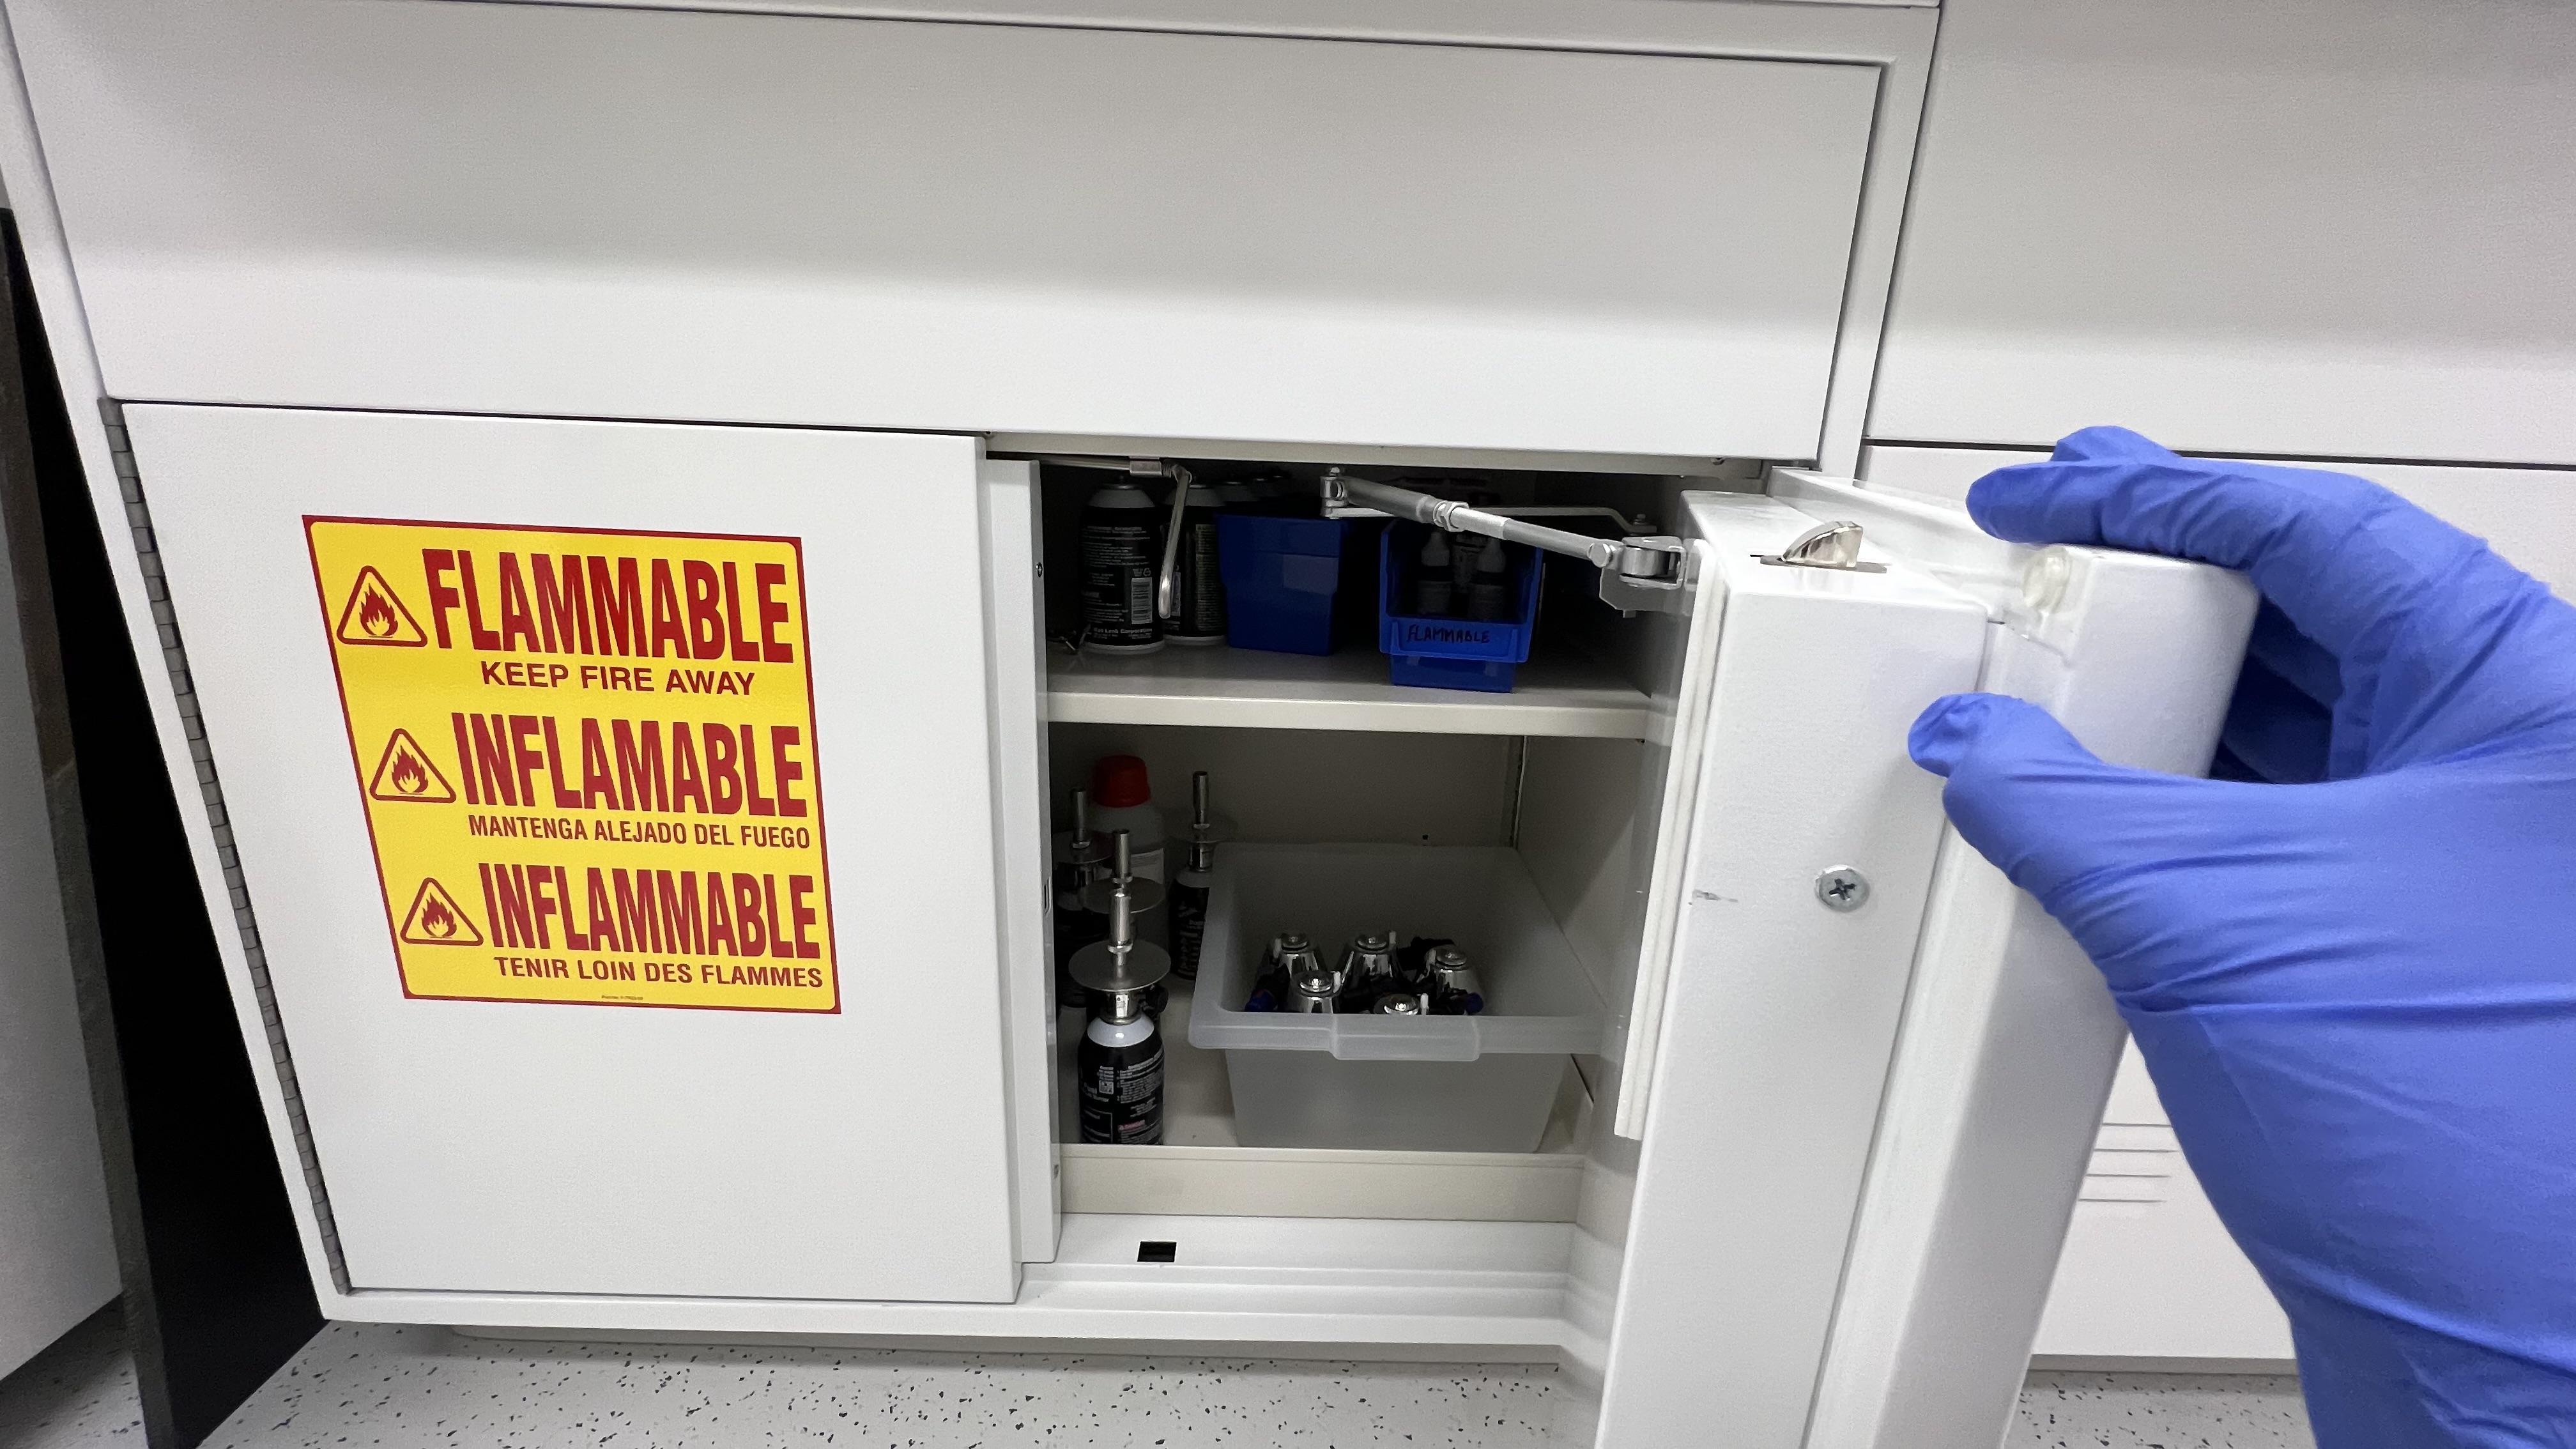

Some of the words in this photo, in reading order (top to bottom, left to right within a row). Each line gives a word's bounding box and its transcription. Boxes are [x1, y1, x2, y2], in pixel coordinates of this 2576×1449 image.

[422, 549, 793, 663] FLAMMABLE
[1407, 624, 1490, 644] FLAMMABLE
[481, 661, 568, 687] KEEP
[581, 666, 654, 691] FIRE
[666, 670, 754, 695] AWAY
[452, 713, 807, 817] INFLAMABLE
[469, 816, 586, 839] MANTENGA
[595, 820, 686, 844] ALEJADO
[694, 824, 735, 845] DEL
[741, 825, 809, 848] FUEGO
[479, 863, 820, 958] INFLAMMABLE
[494, 957, 567, 978] TENIR
[578, 961, 634, 981] LOIN
[645, 963, 691, 983] DES
[701, 965, 822, 987] FLAMMES
